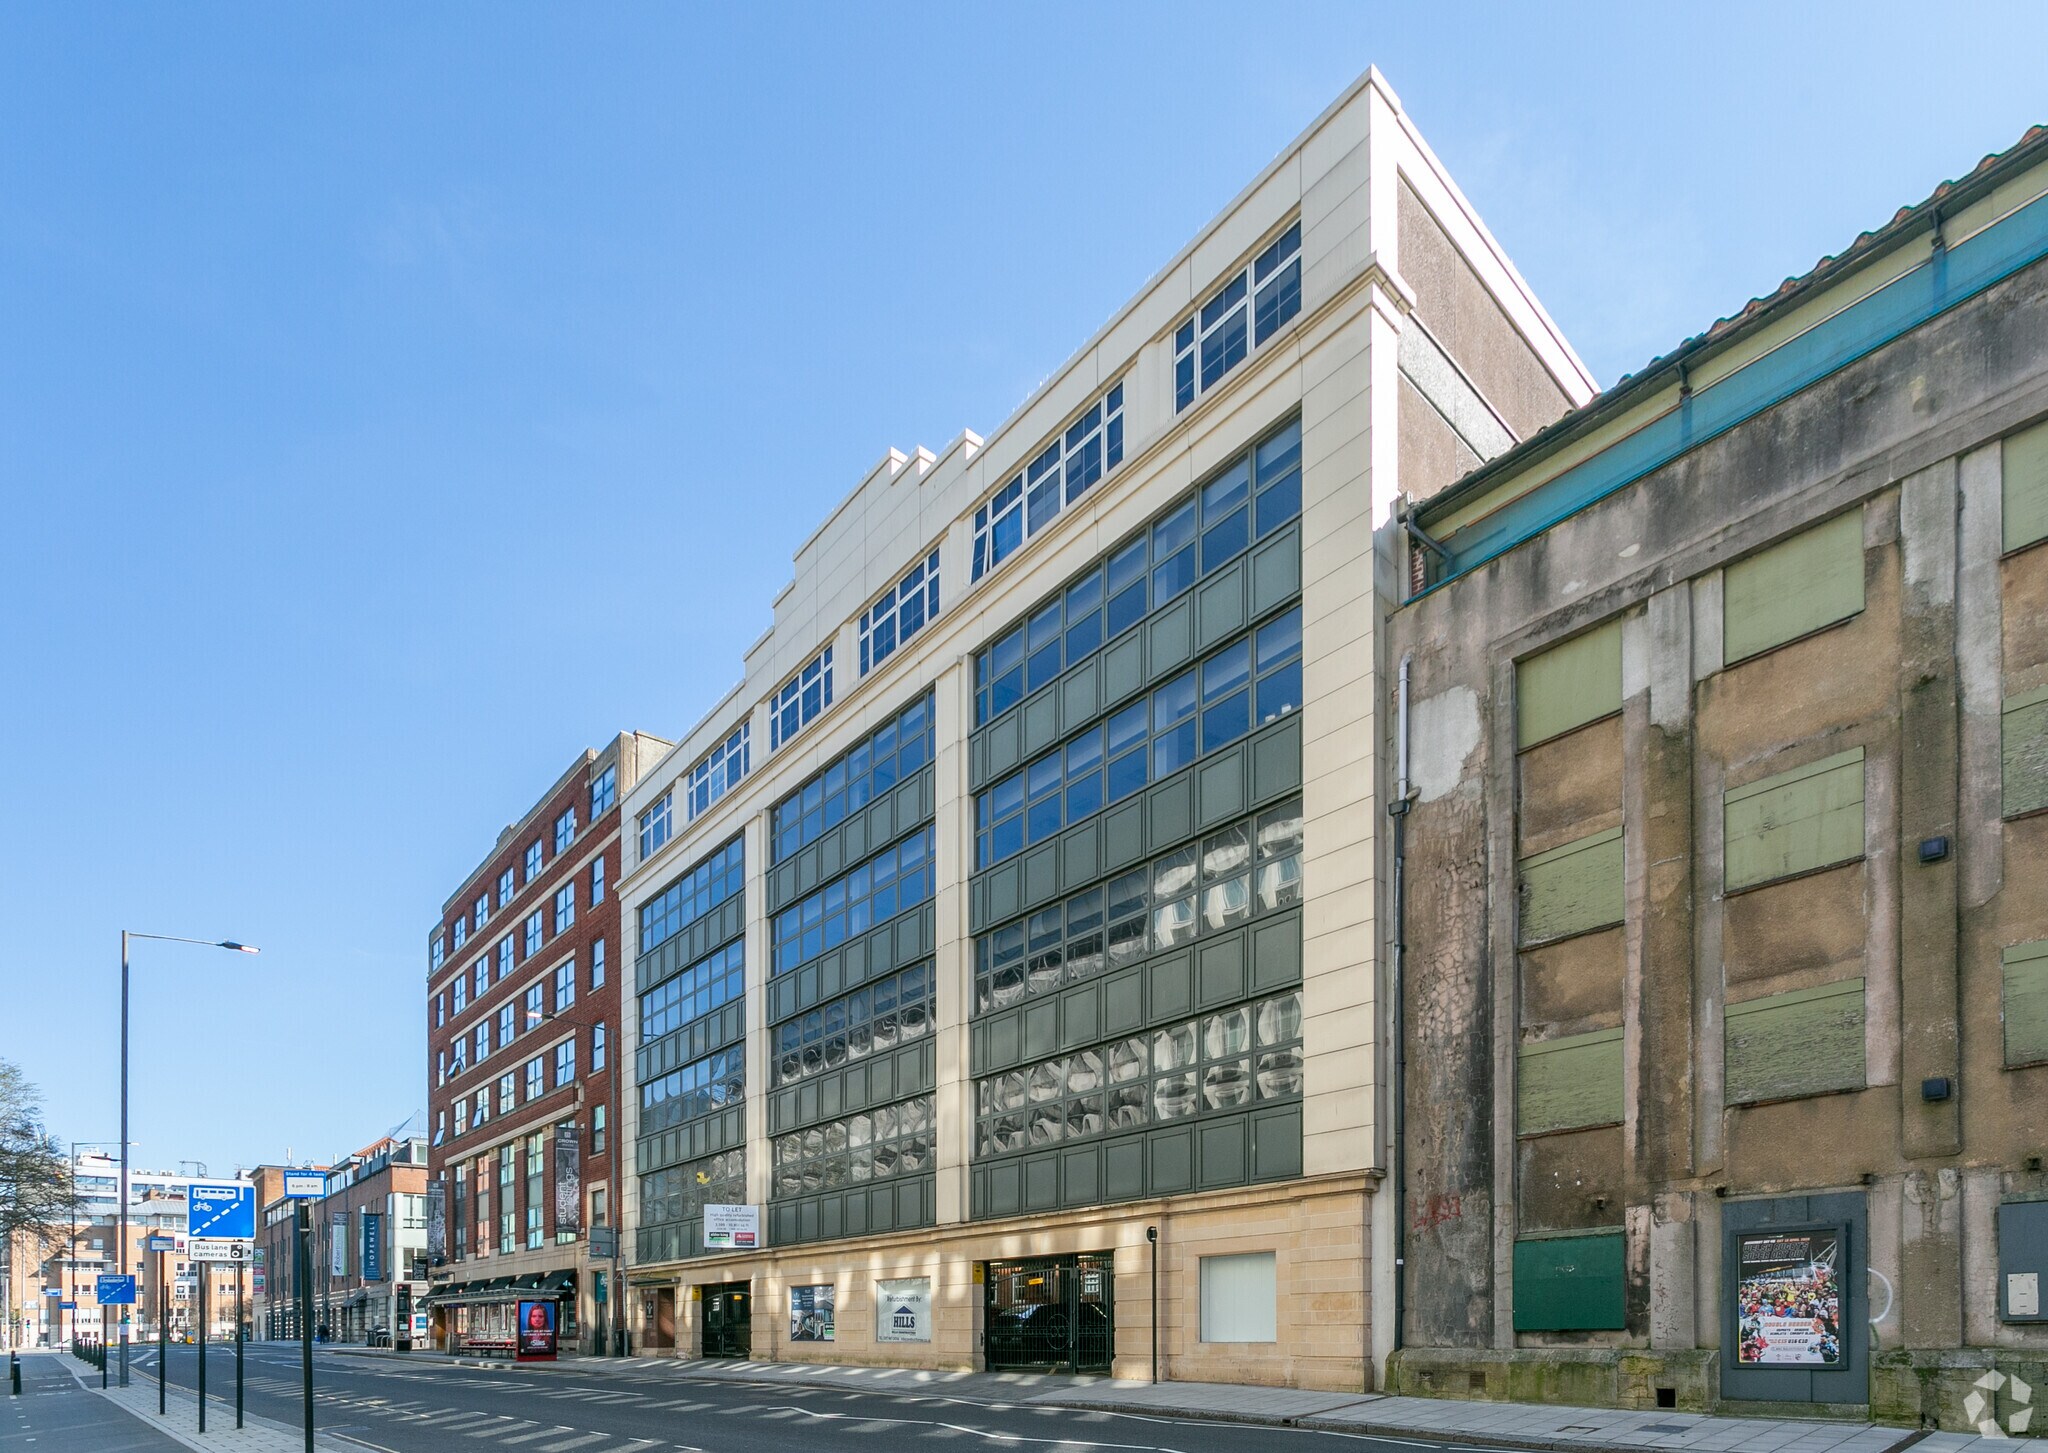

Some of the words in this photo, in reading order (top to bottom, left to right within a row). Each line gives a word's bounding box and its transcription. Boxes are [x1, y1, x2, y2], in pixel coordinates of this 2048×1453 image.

[566, 1167, 574, 1206] lettings
[1743, 1244, 1773, 1253] WELSH
[1773, 1242, 1809, 1251] RUGBY'S
[1742, 1251, 1770, 1260] SUPER
[1770, 1250, 1788, 1259] DAY
[1789, 1250, 1806, 1258] OUT
[894, 1316, 915, 1328] HILLS
